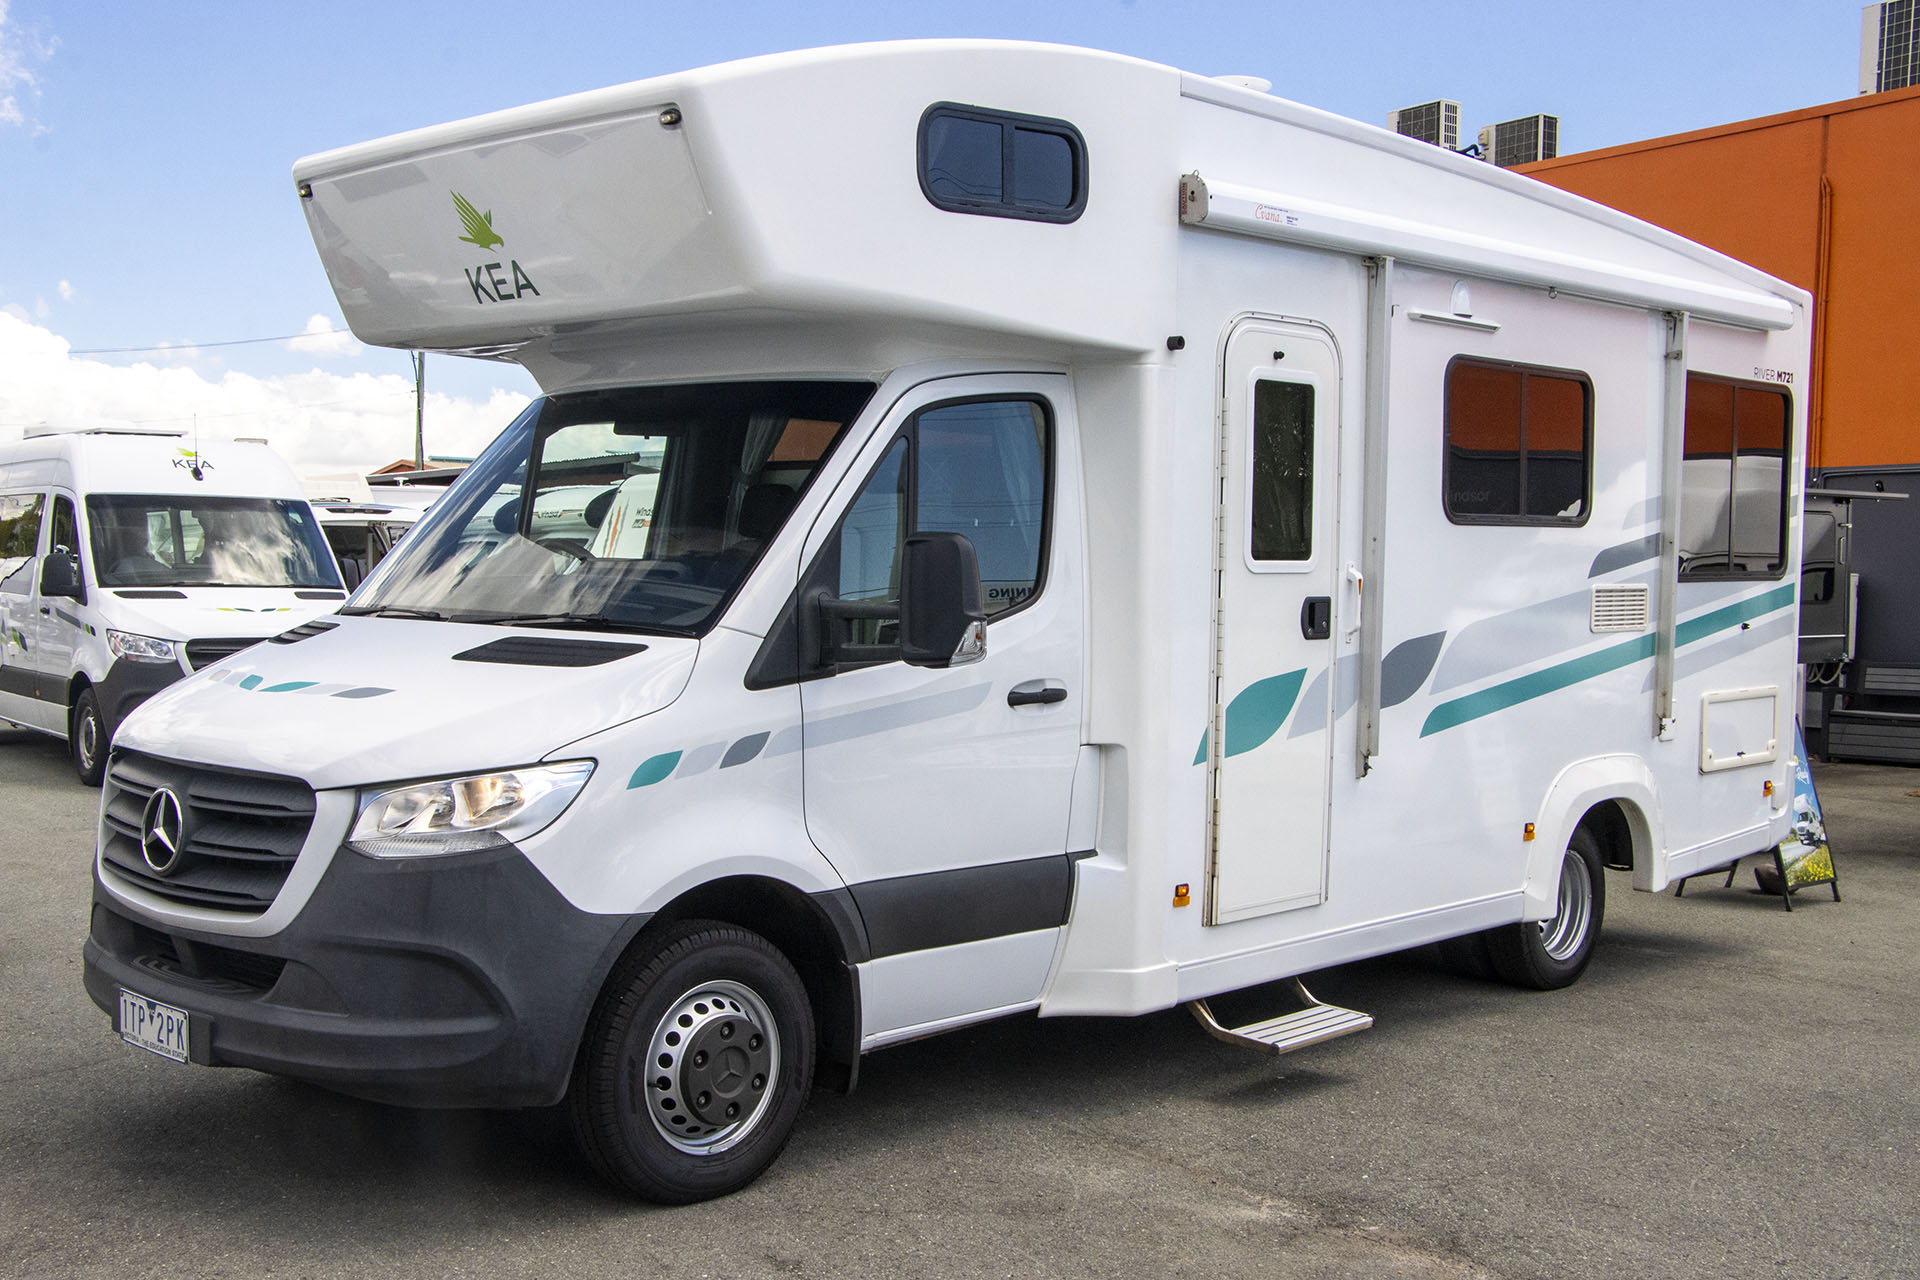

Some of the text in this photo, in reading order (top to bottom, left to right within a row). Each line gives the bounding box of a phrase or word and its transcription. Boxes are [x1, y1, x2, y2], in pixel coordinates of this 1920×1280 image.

[464, 259, 541, 305] KEA
[1753, 366, 1794, 384] RIVER M721
[171, 458, 215, 470] KEA
[123, 998, 185, 1051] 1TP 2PK
